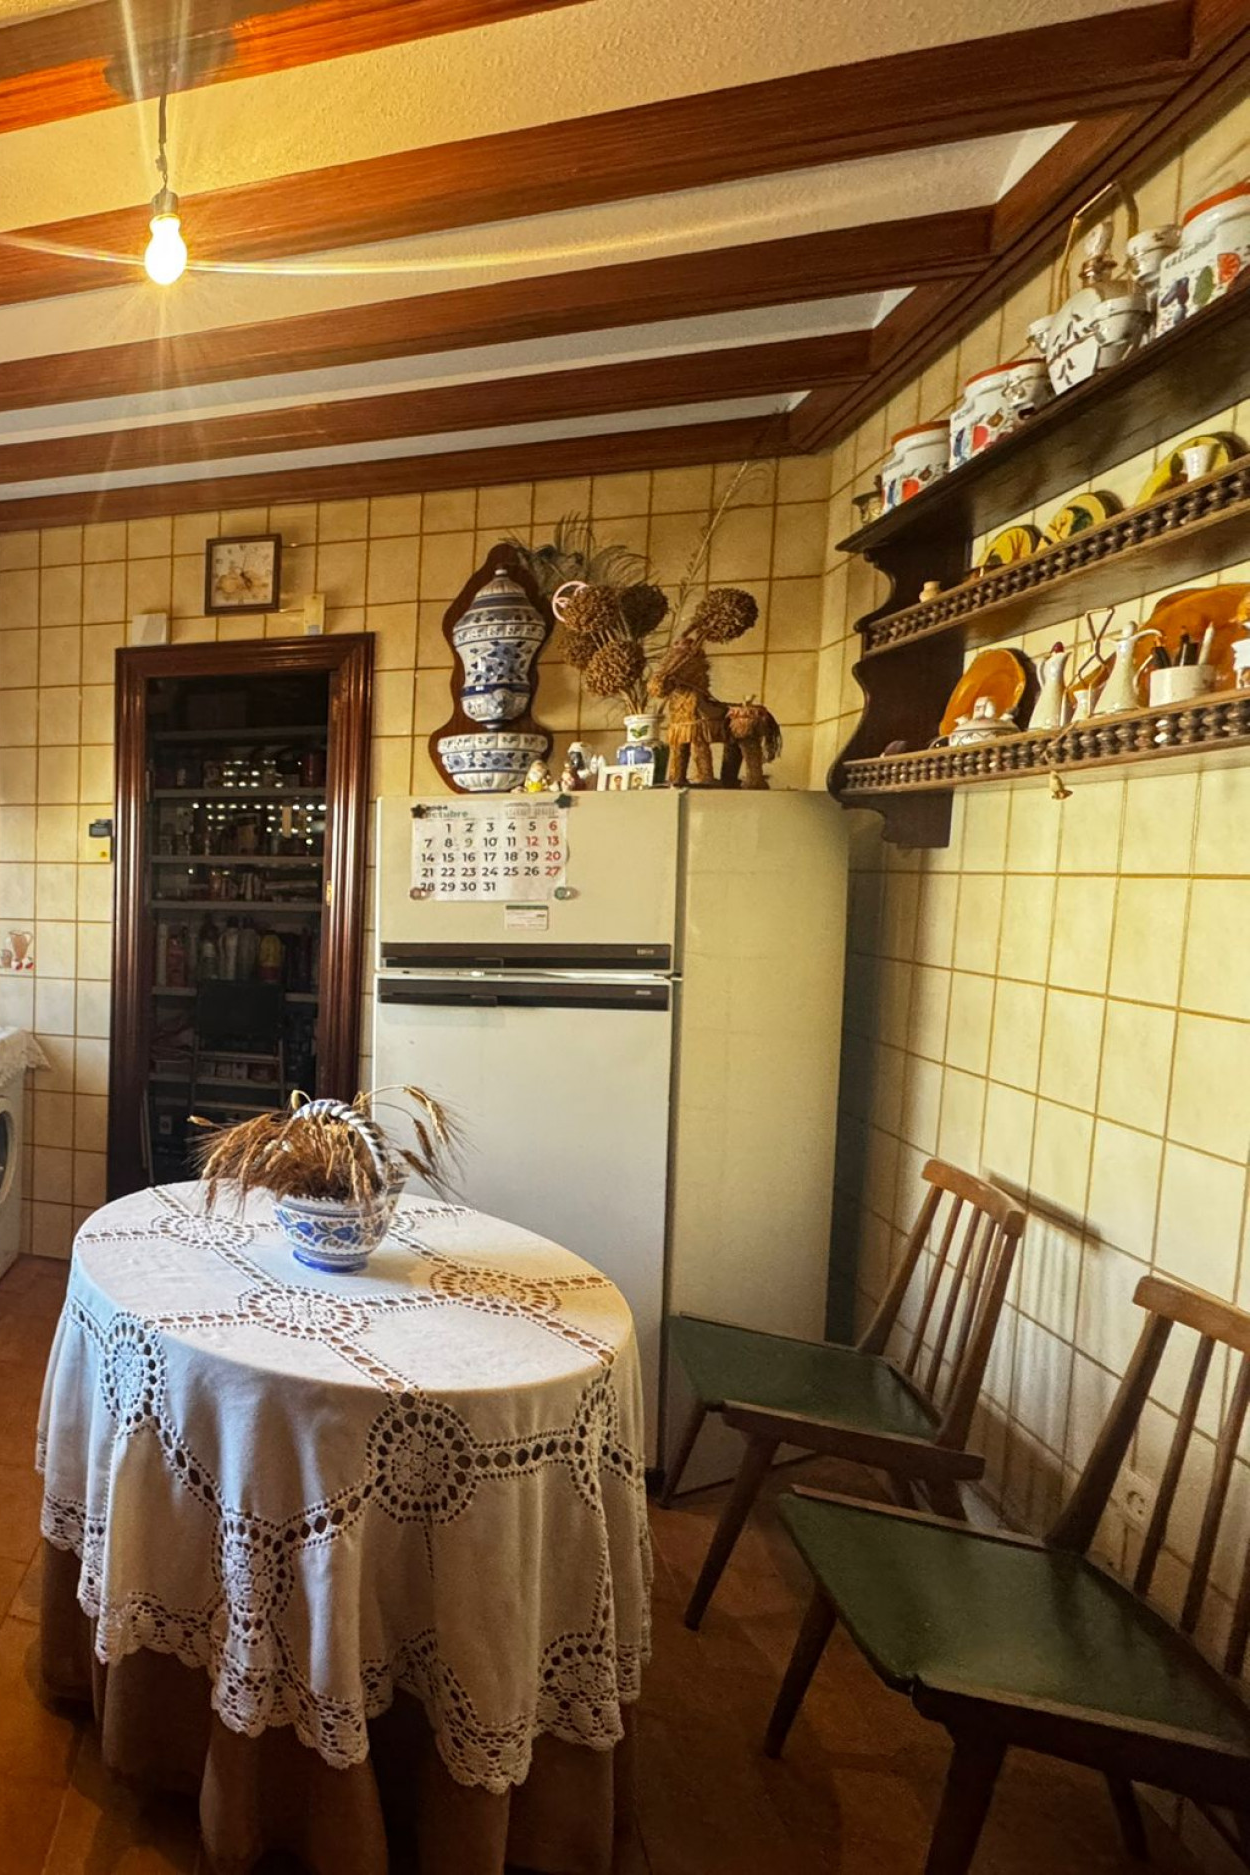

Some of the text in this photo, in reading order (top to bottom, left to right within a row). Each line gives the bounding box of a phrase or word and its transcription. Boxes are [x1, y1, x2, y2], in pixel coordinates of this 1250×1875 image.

[446, 820, 557, 833] 1 2 3 4 5 6
[424, 835, 559, 848] 7 8 9 10 11 12 13
[421, 851, 561, 862] 14 15 16 17 18 19 20
[421, 866, 561, 877] 21 22 23 24 25 26 27
[420, 882, 496, 892] 28 29 30 31
